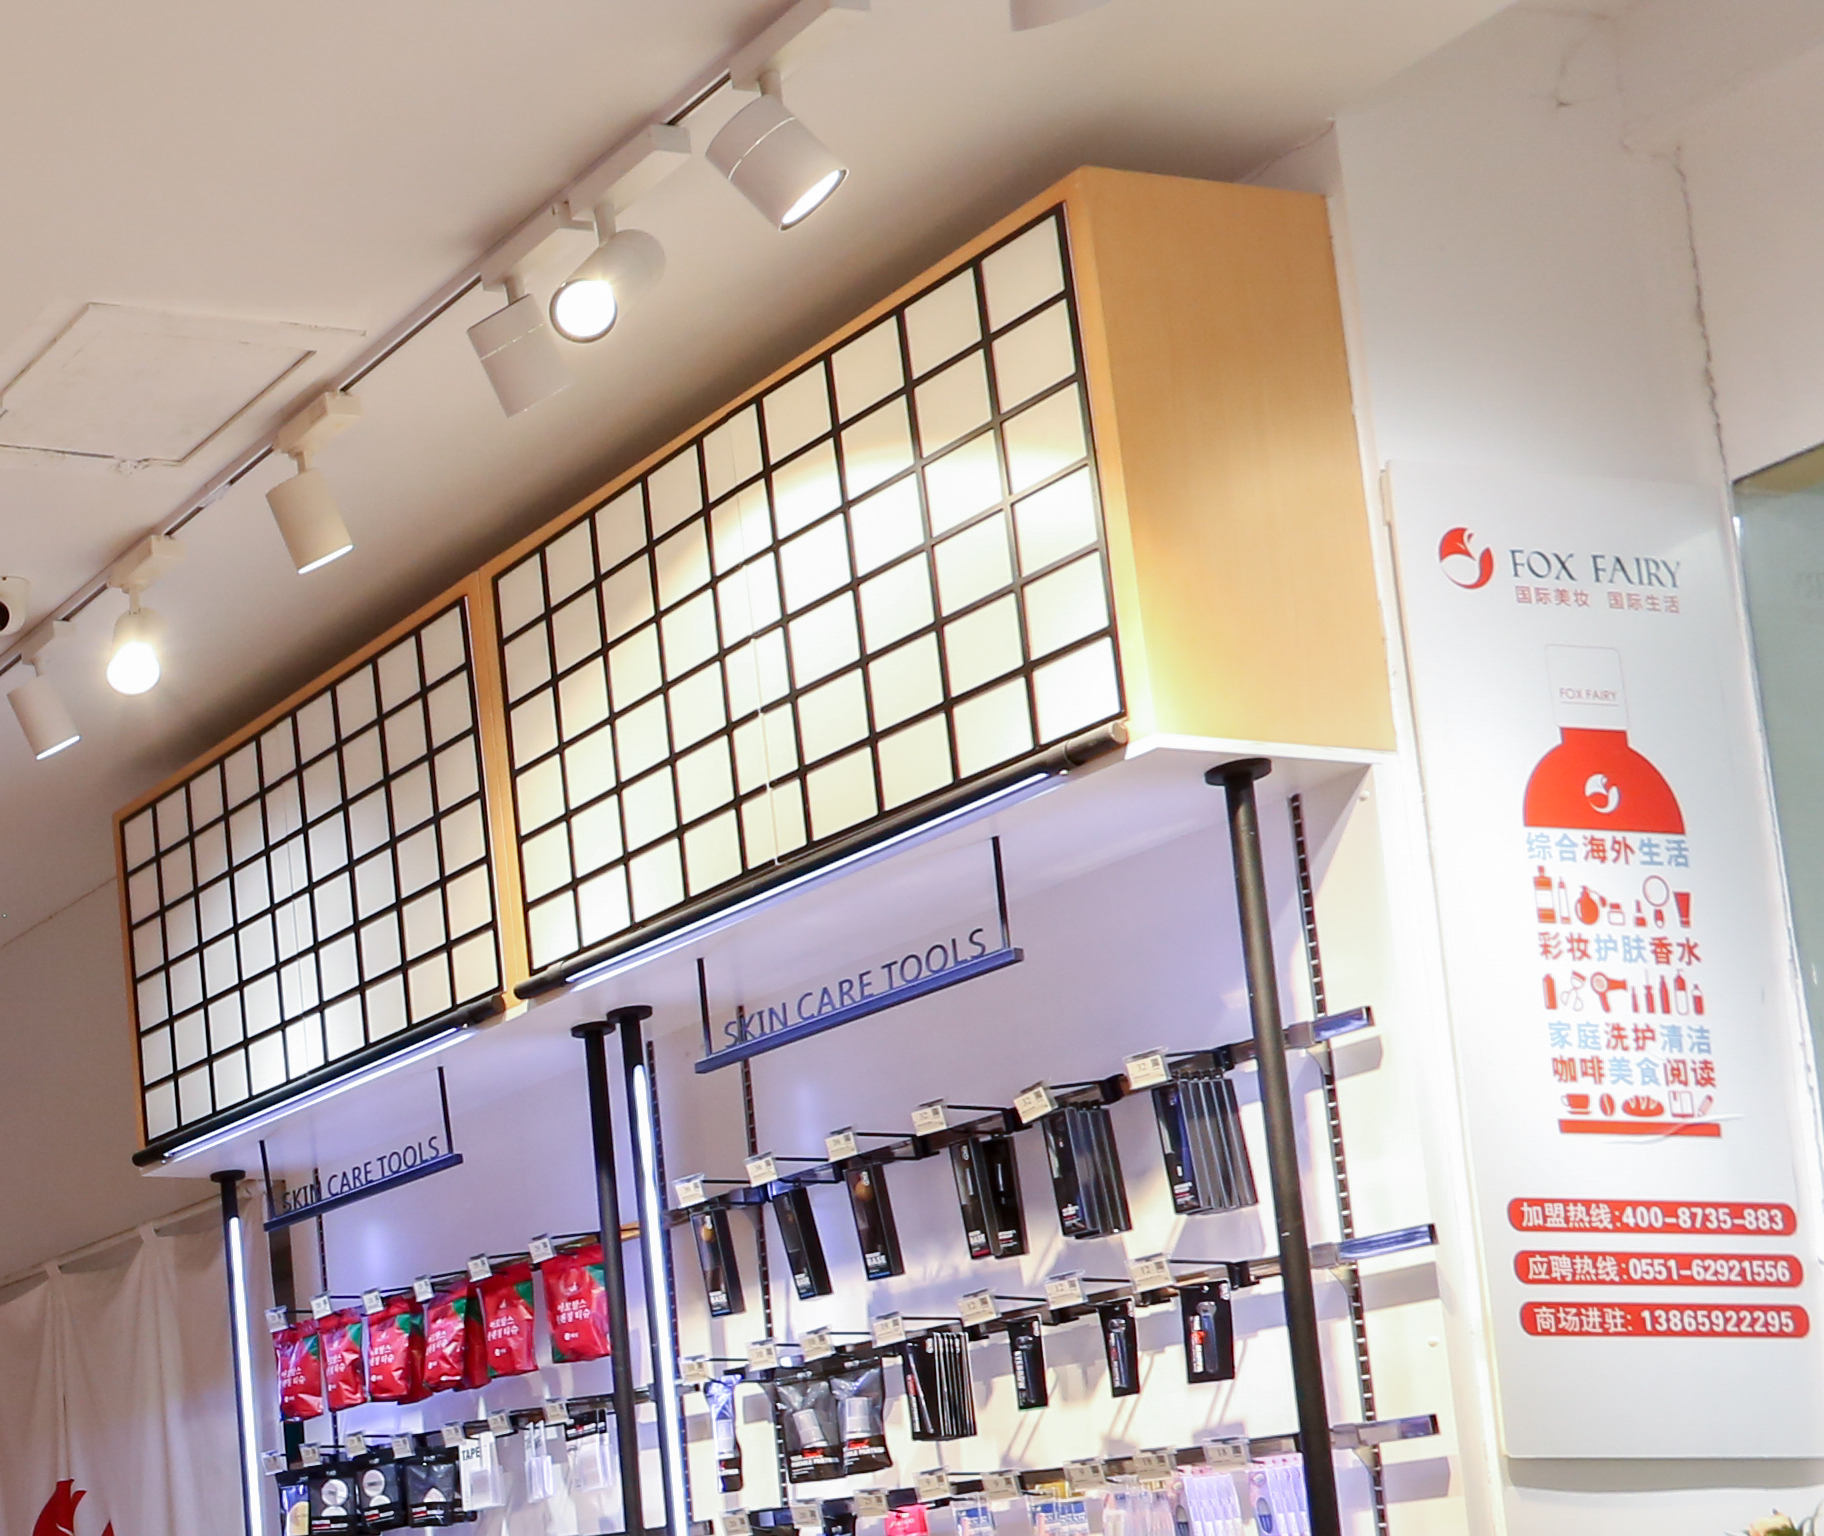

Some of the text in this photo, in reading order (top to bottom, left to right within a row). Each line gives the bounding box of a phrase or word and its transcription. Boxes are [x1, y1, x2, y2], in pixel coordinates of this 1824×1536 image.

[1510, 550, 1682, 589] FOX FAIRY
[1515, 586, 1680, 614] 国际美妆 国际生活
[1560, 688, 1617, 701] FOX FAIRY
[1526, 832, 1690, 868] 综合海外生活
[1538, 932, 1701, 966] 彩妆护肤香水
[724, 927, 988, 1050] SKIN CARE TOOLS
[1549, 1022, 1712, 1055] 家庭洗护清洁
[1552, 1056, 1717, 1089] 咖啡美食阅读
[282, 1135, 441, 1213] SKIN CARE TOOLS
[1520, 1201, 1784, 1231] 加盟热线:400-8735-883
[1527, 1254, 1792, 1283] 应聘热线:0551-62921556
[1534, 1306, 1795, 1334] 商场进驻: 13865922295
[462, 1445, 480, 1462] TAPE
